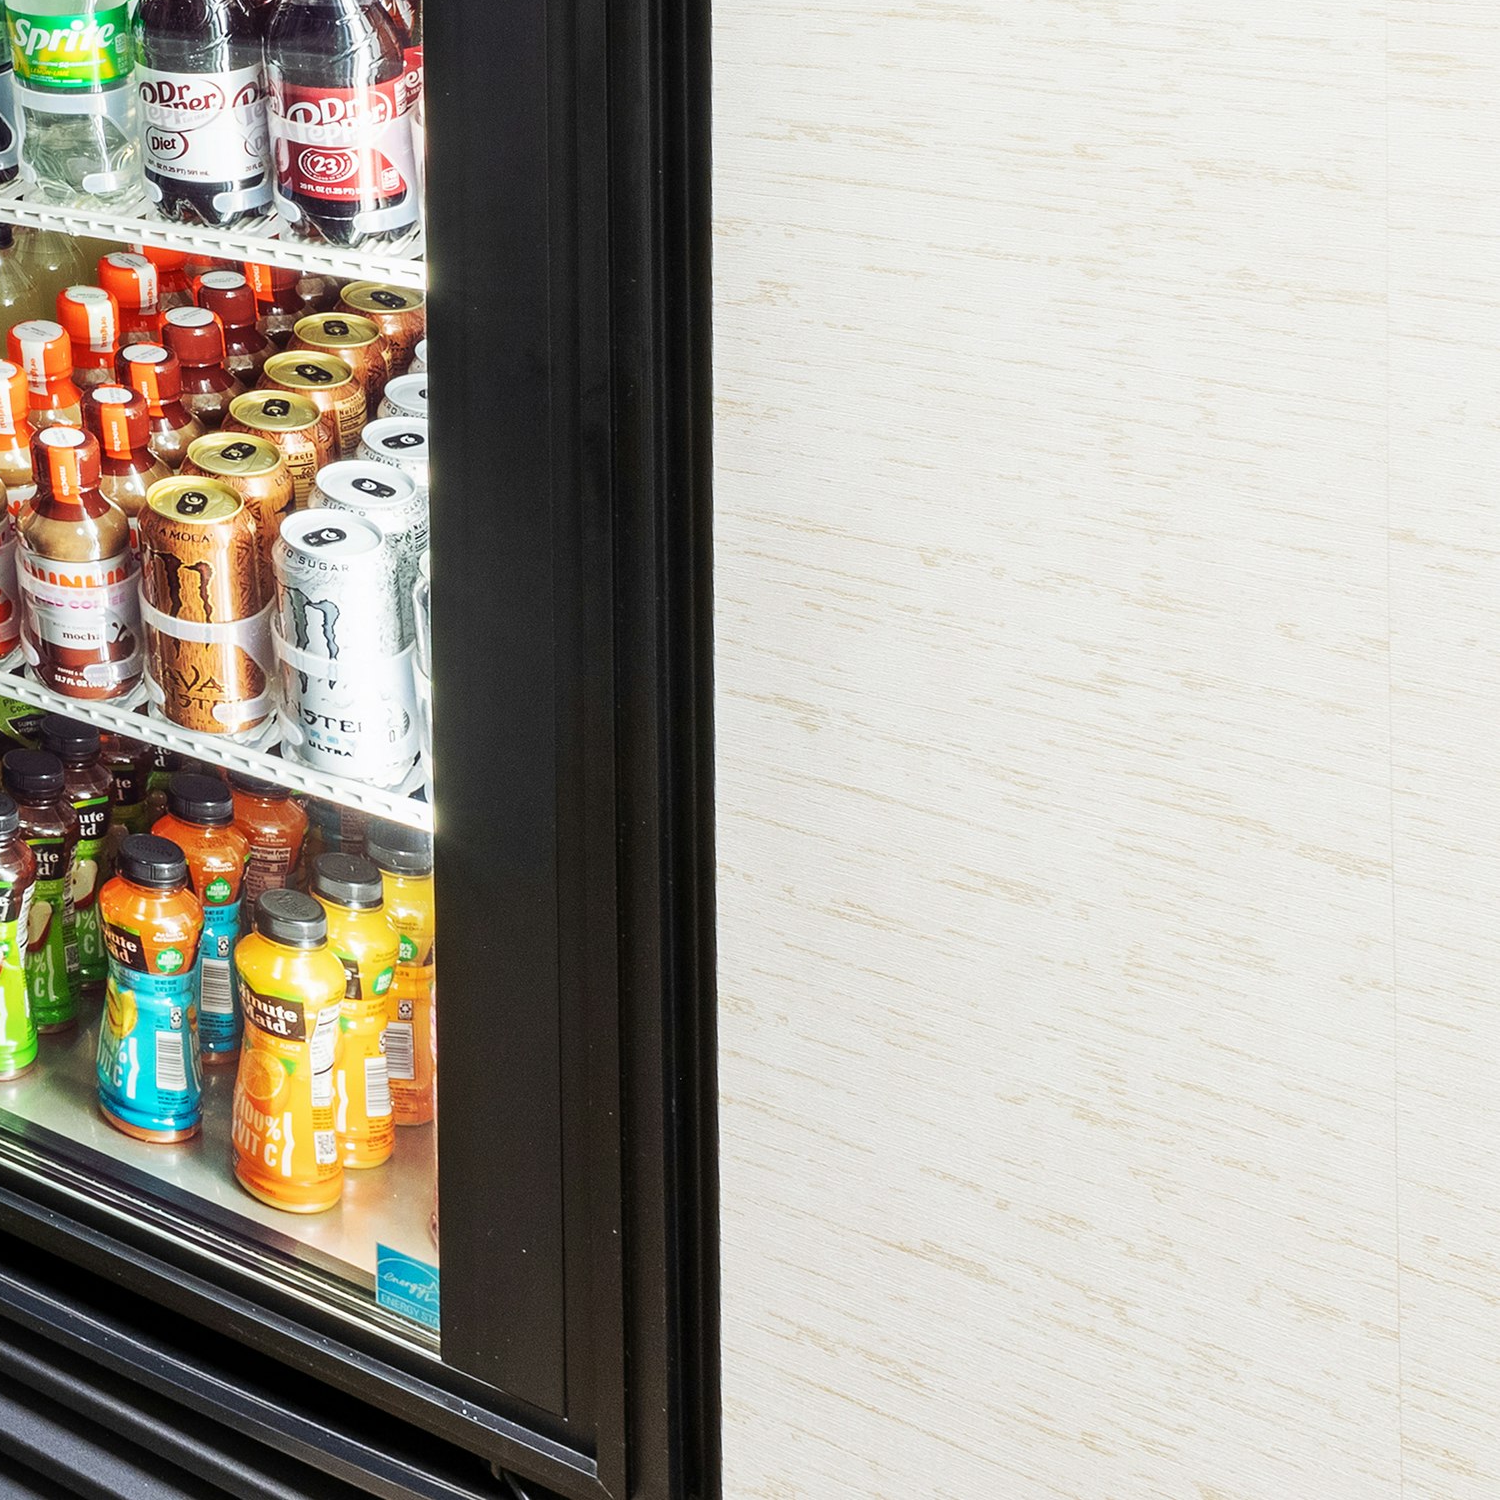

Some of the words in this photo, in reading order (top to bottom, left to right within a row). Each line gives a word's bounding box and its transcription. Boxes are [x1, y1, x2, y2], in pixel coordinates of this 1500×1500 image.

[14, 18, 115, 56] Sprite
[156, 81, 191, 104] Dr
[151, 136, 177, 151] Diet
[313, 155, 338, 175] 23
[110, 420, 120, 452] mocha
[287, 451, 315, 461] Facts
[59, 465, 70, 496] mocha
[297, 555, 350, 573] SUGAR
[308, 740, 353, 757] ULTRA
[113, 1066, 123, 1088] C
[241, 1092, 282, 1142] 100%
[238, 1128, 261, 1157] VIT
[263, 1142, 277, 1168] C
[381, 1293, 420, 1317] ENERGY
[421, 1311, 439, 1324] STA
